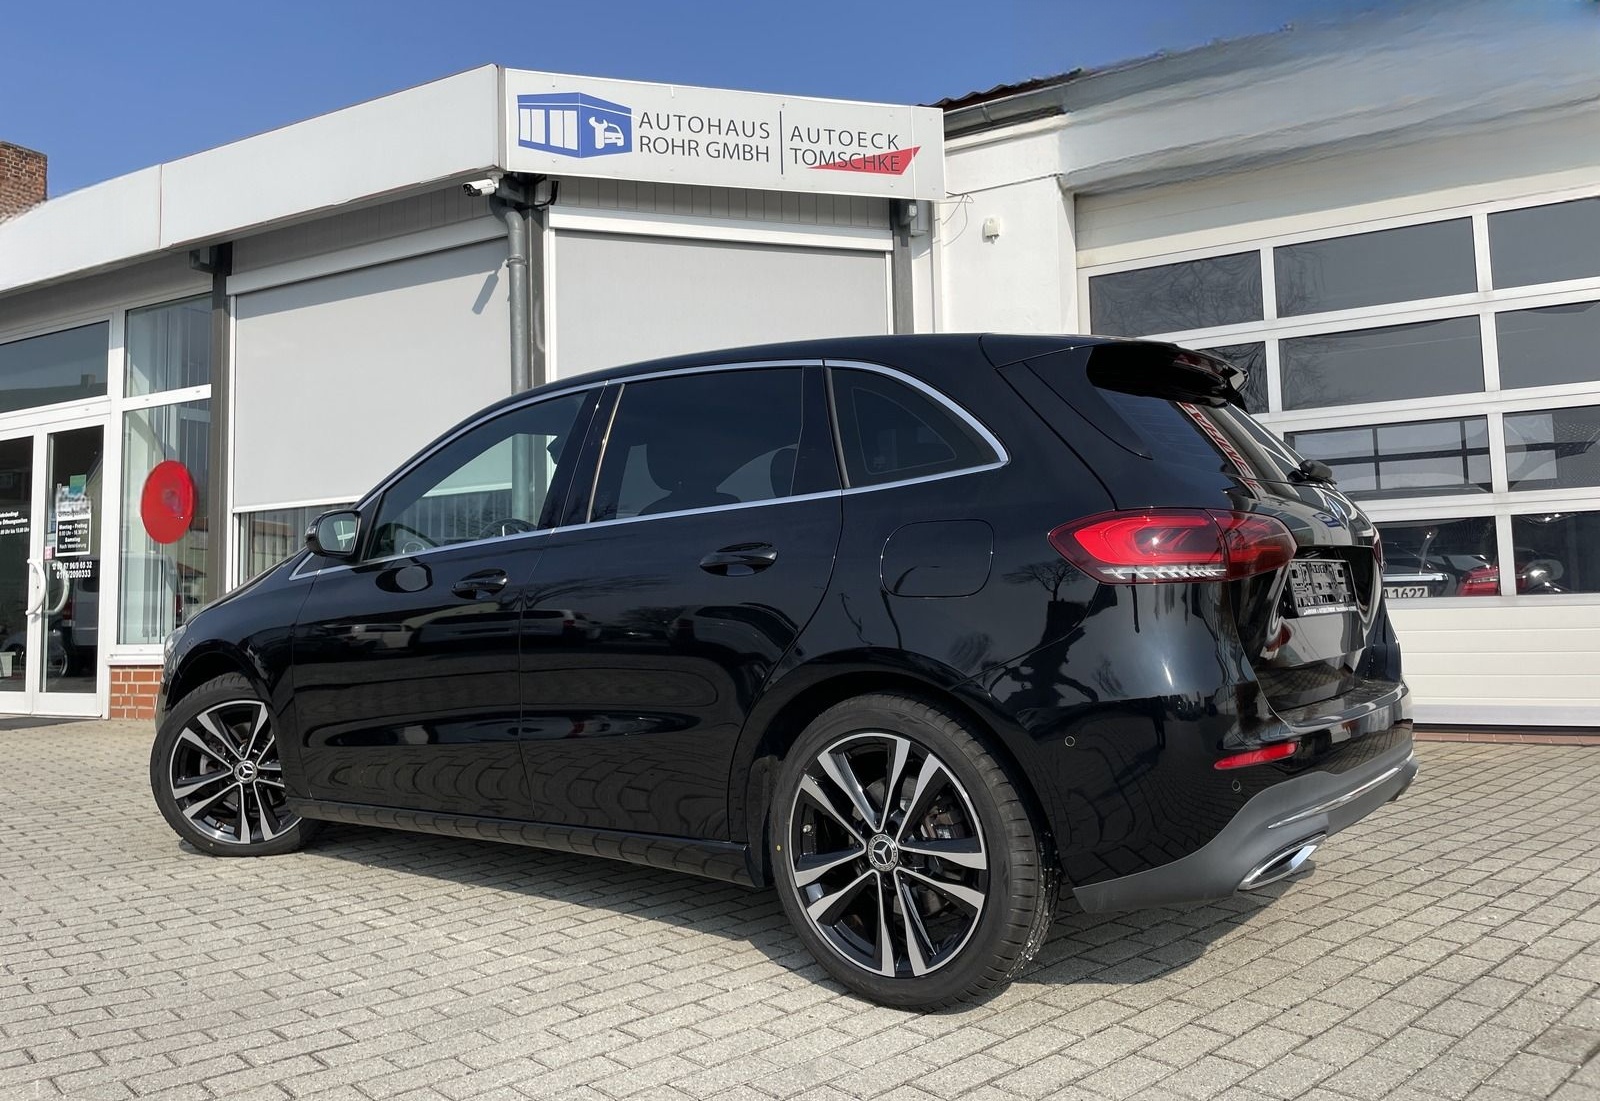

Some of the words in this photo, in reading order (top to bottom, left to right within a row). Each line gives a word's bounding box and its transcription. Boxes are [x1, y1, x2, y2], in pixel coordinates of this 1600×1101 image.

[639, 112, 770, 139] AUTOHAUS
[790, 125, 899, 150] AUTOECK
[640, 135, 699, 157] ROHR
[705, 141, 769, 162] GMBH
[789, 147, 900, 171] TOMSCHKE
[1392, 588, 1425, 598] 1627
